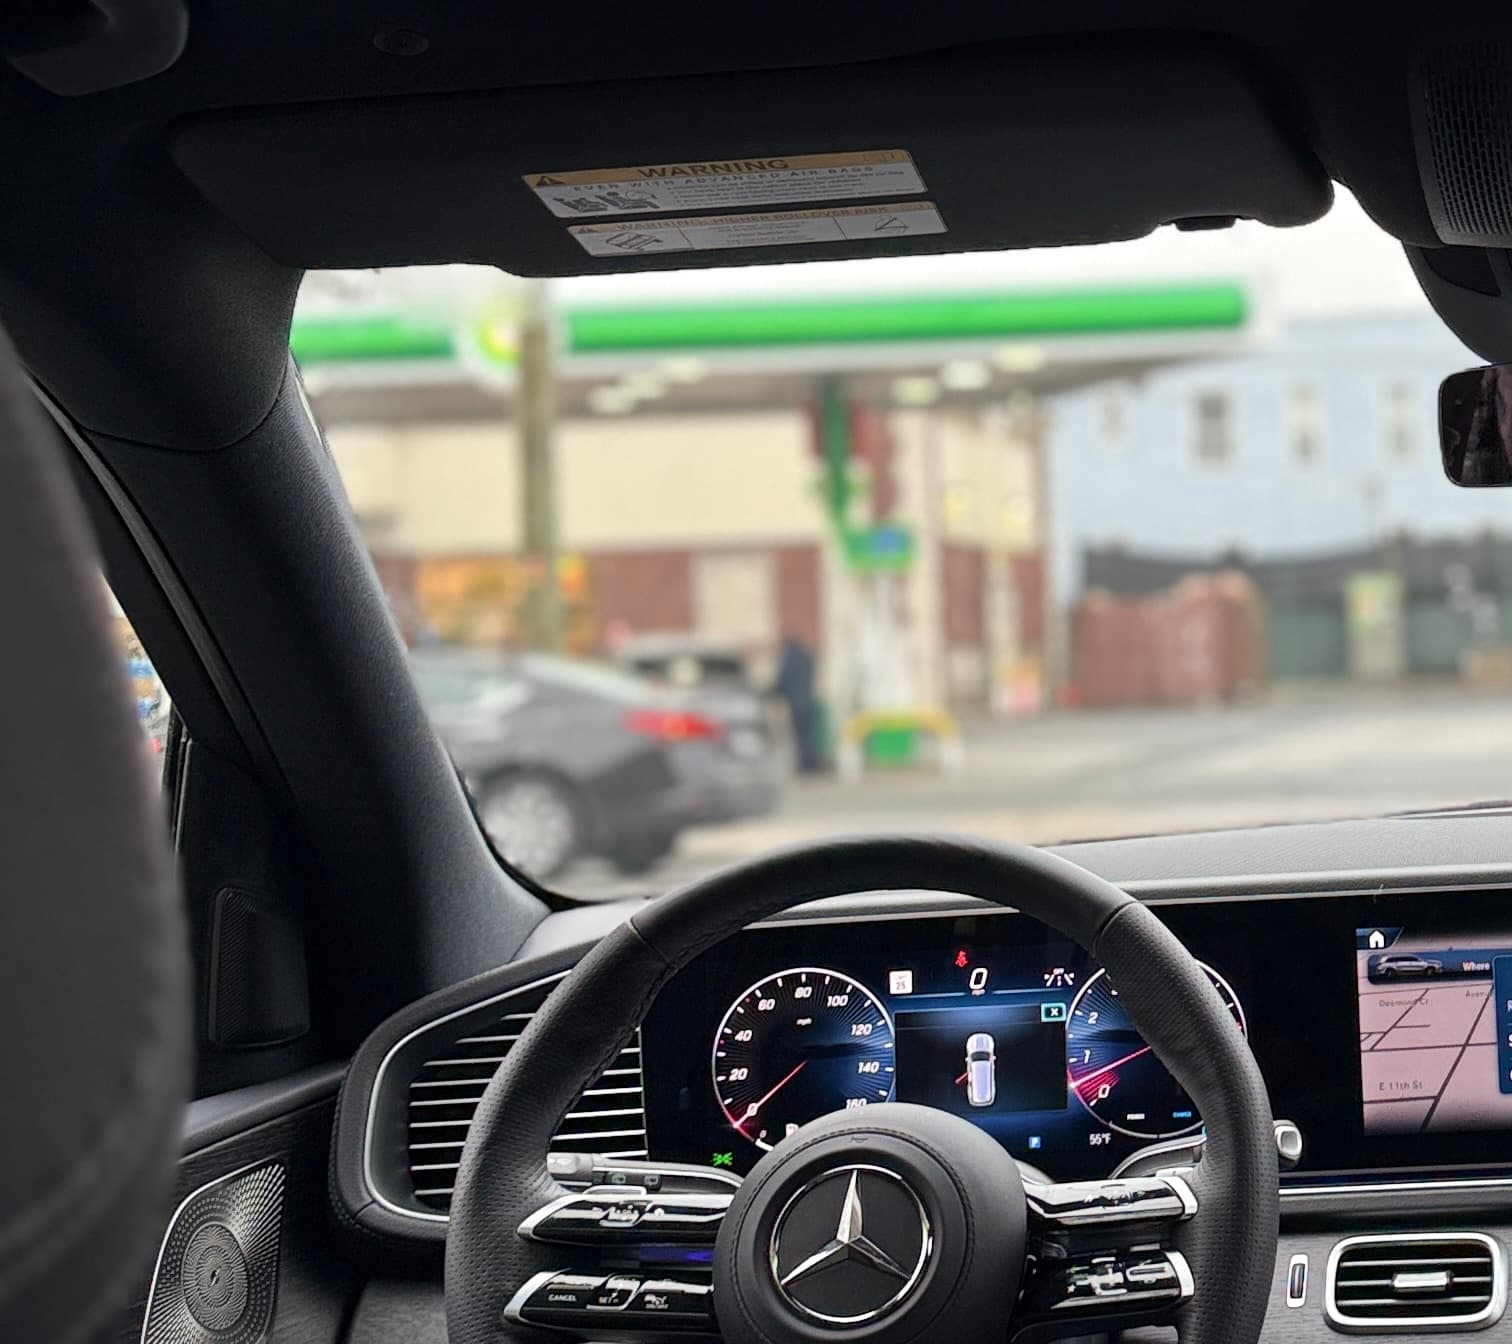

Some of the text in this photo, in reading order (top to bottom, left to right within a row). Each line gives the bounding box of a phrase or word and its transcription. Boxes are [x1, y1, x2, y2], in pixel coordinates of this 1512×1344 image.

[638, 159, 789, 178] WARNING
[1463, 961, 1490, 972] Where
[969, 967, 988, 990] 0
[794, 986, 812, 999] 80
[895, 981, 906, 991] 25
[758, 998, 775, 1011] 60
[826, 994, 848, 1007] 100
[1087, 1012, 1098, 1024] 2
[734, 1029, 752, 1042] 40
[850, 1023, 872, 1036] 120
[1083, 1050, 1090, 1063] 1
[858, 1061, 880, 1074] 140
[728, 1067, 748, 1082] 20
[1098, 1084, 1111, 1100] 0
[1379, 1080, 1423, 1091] E 11th St
[1089, 1132, 1112, 1146] 55°F
[547, 1293, 577, 1303] CANCEL
